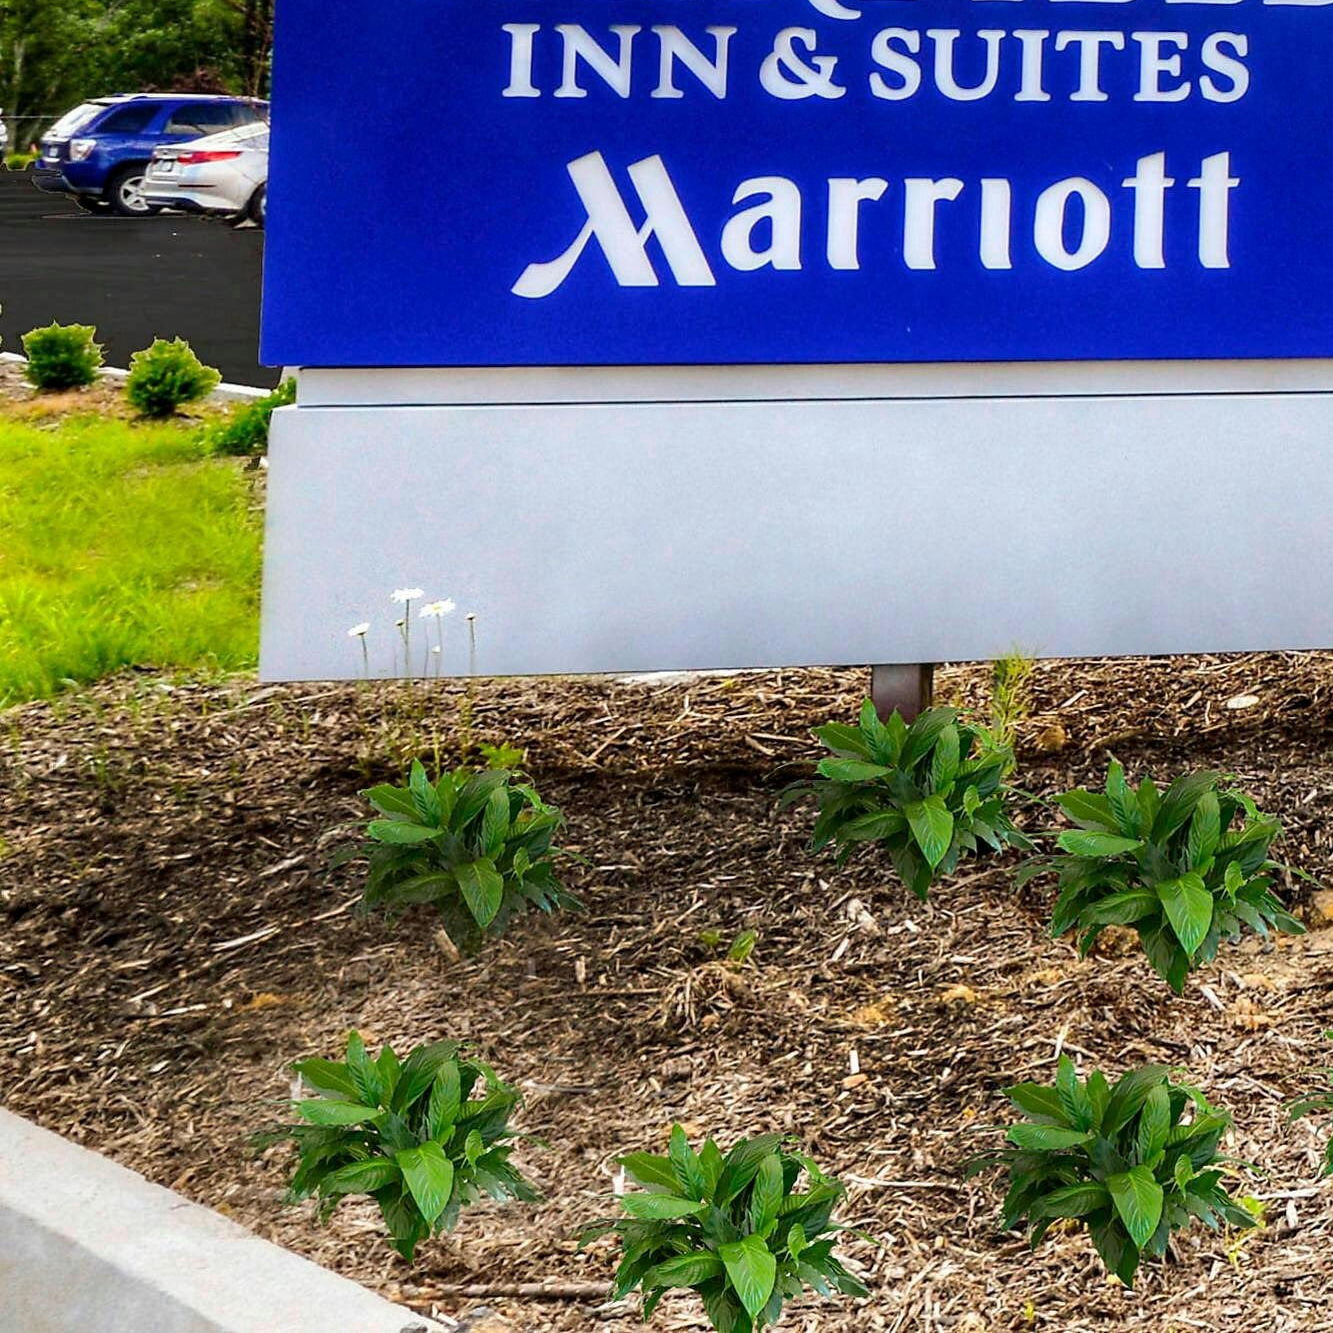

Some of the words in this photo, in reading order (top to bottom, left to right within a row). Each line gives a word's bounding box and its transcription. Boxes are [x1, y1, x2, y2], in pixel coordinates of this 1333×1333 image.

[501, 23, 738, 99] INN
[759, 26, 848, 100] &
[869, 27, 1251, 103] SUITES
[510, 150, 1241, 300] Marriott
